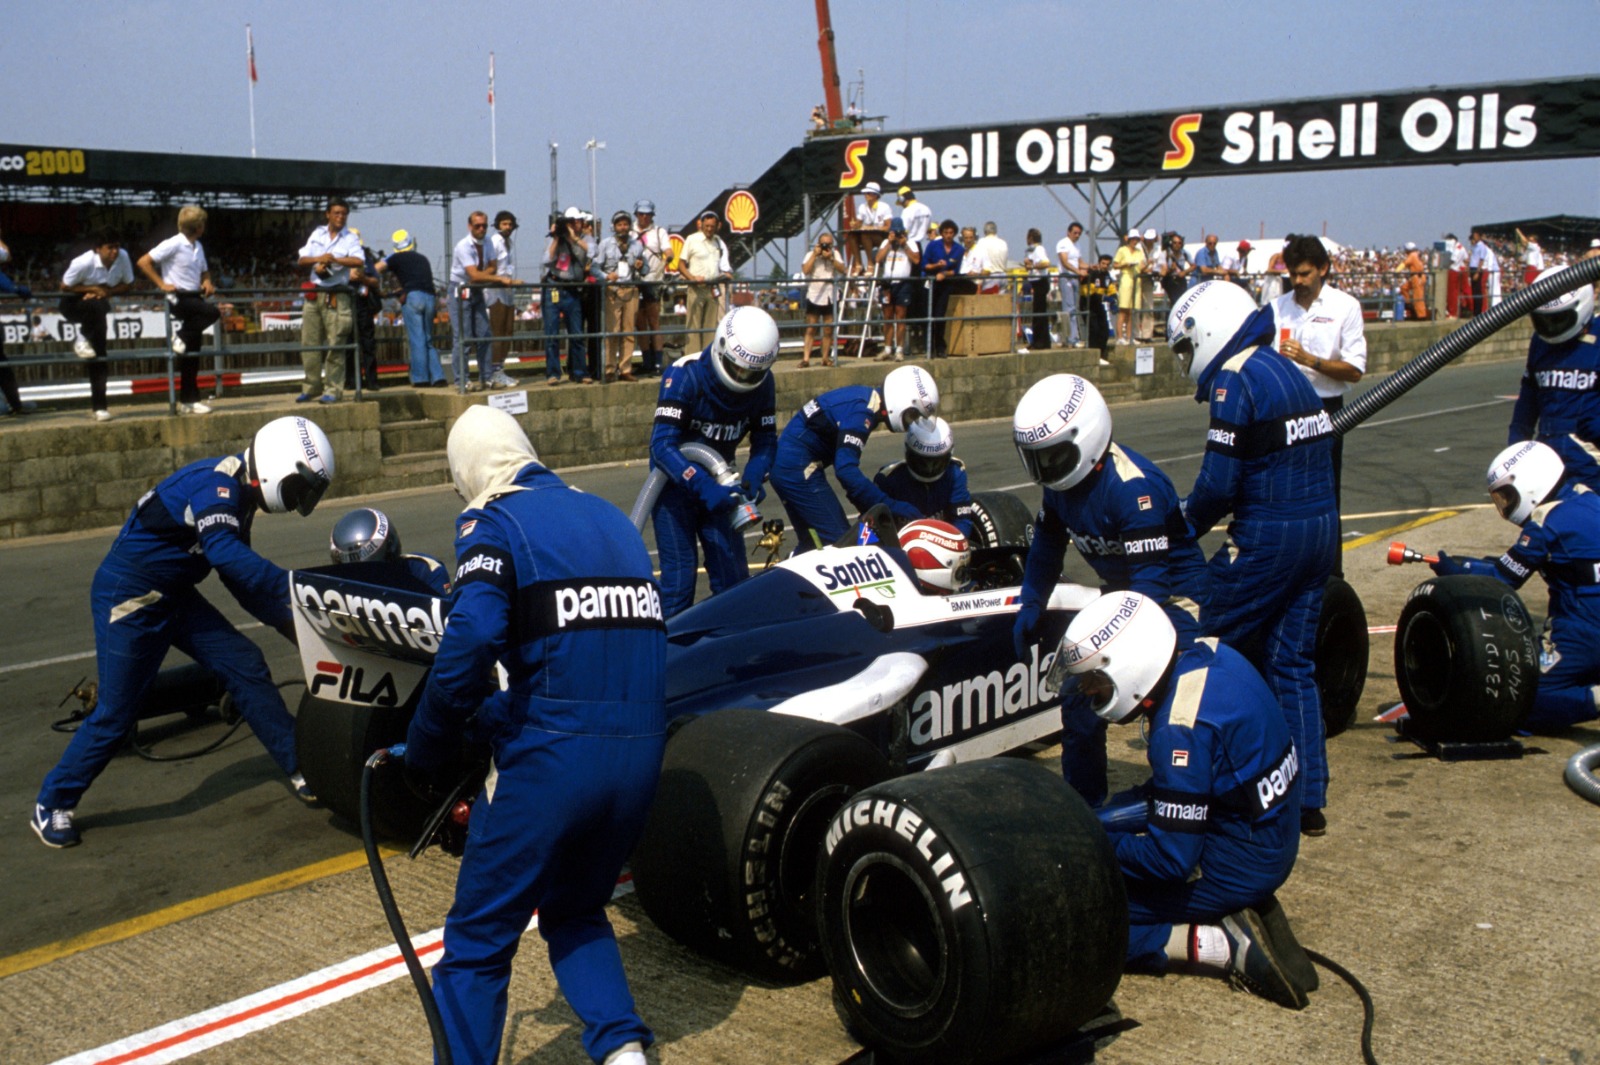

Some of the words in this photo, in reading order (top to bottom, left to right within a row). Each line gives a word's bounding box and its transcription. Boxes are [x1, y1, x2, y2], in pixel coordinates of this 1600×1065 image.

[1222, 101, 1378, 165] Shell
[1400, 93, 1537, 153] Oils
[0, 156, 25, 171] co
[25, 149, 86, 176] 2000
[884, 131, 999, 184] Shell
[1015, 124, 1115, 176] Oils
[4, 324, 29, 344] BP
[118, 320, 141, 339] BP
[733, 344, 775, 364] parmalat
[913, 440, 948, 453] parmalat
[919, 531, 959, 551] parmalat
[295, 583, 450, 654] parmal
[951, 601, 972, 612] BMW
[1090, 596, 1139, 649] parmalat
[310, 661, 398, 706] FILA
[825, 799, 972, 911] MICHELIN
